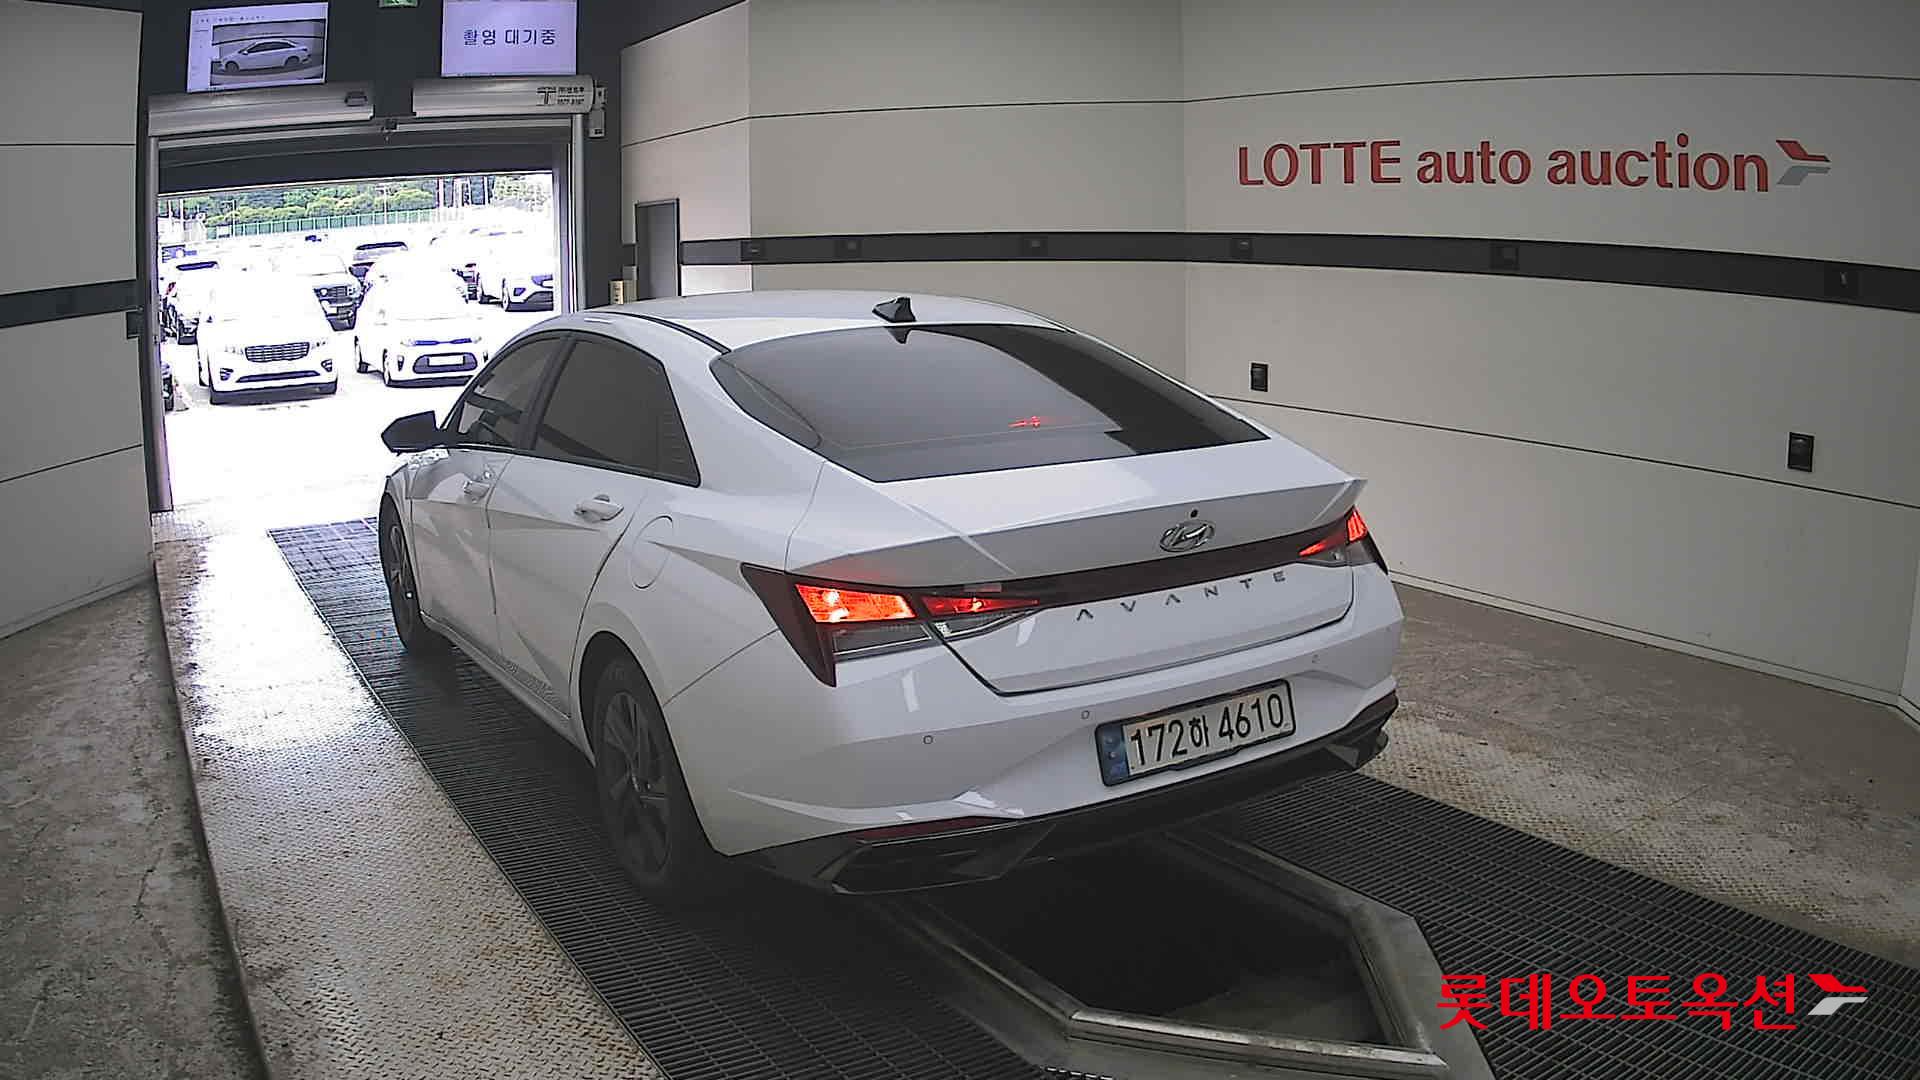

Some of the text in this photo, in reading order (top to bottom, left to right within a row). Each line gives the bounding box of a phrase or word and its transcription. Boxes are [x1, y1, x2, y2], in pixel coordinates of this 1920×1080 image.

[464, 28, 556, 46] 촬영 대기중
[1238, 132, 1769, 193] LOTTE auto auction
[1076, 571, 1286, 621] AVANTE
[1130, 693, 1285, 766] 172하 4610
